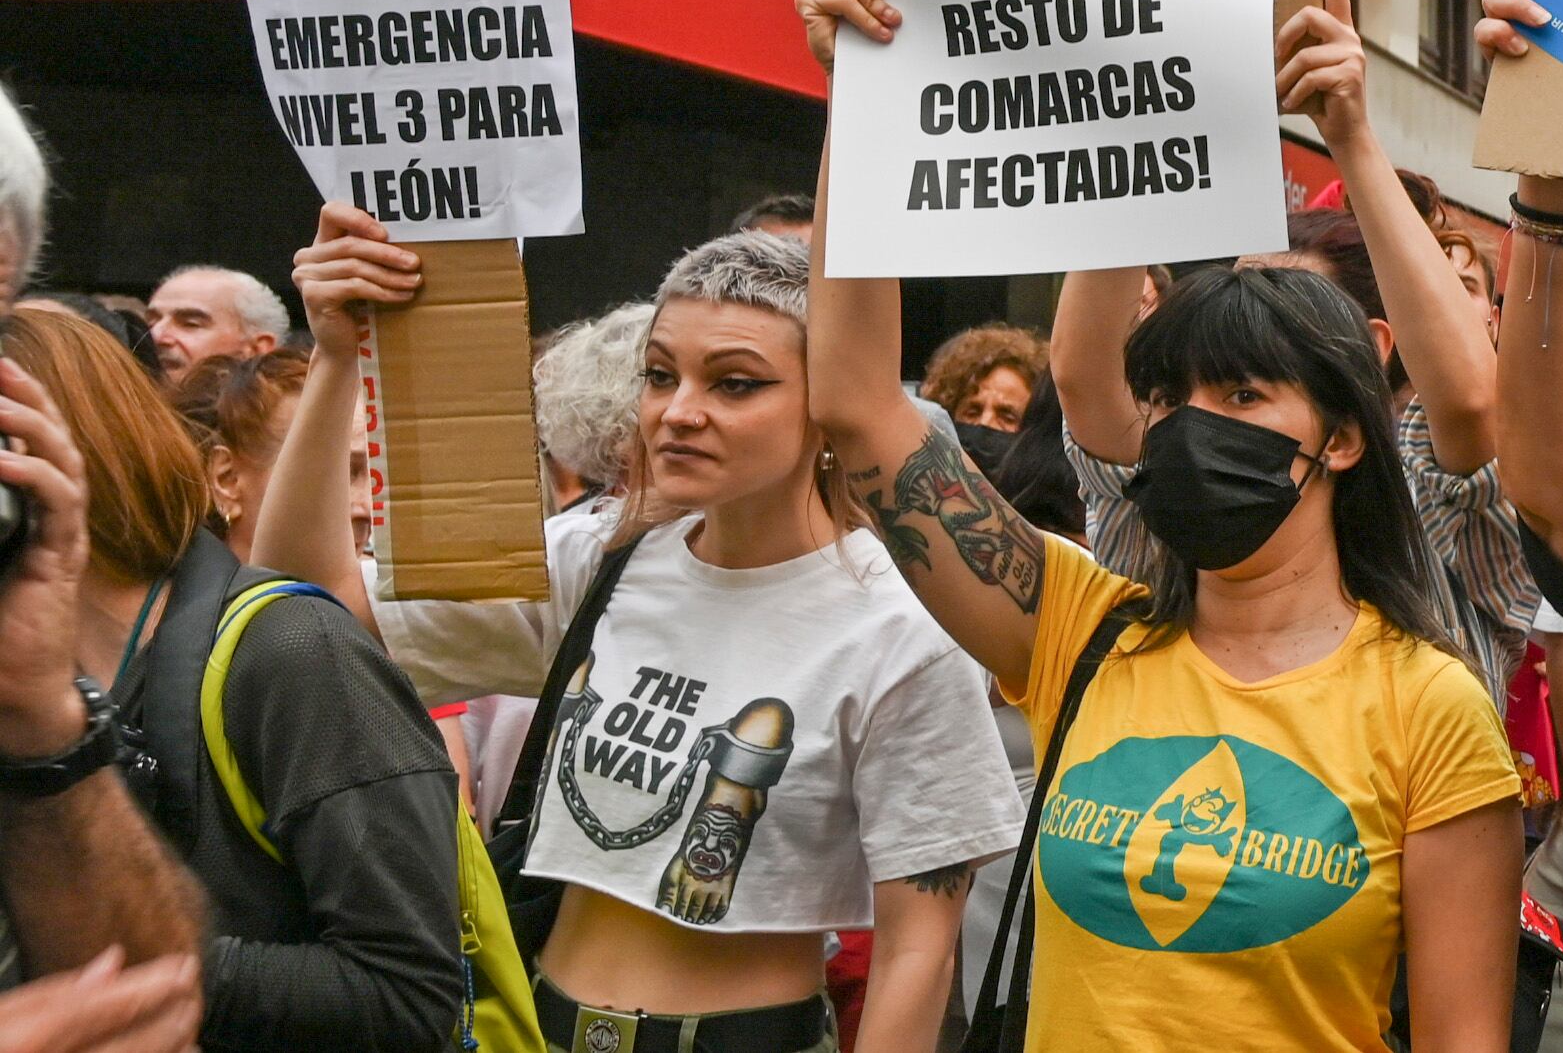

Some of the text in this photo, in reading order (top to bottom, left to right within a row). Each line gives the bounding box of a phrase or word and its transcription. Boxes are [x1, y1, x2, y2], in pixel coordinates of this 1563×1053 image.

[265, 5, 554, 71] EMERGENCIA
[278, 83, 564, 147] NIVEL 3 PARA
[919, 56, 1196, 136] COMARCAS
[350, 158, 481, 222] LEÓN!
[906, 135, 1212, 211] AFECTADAS!
[629, 666, 708, 717] THE
[603, 702, 687, 753] OLD
[584, 735, 678, 795] WAY
[1042, 793, 1364, 888] SECRET BRIDGE
